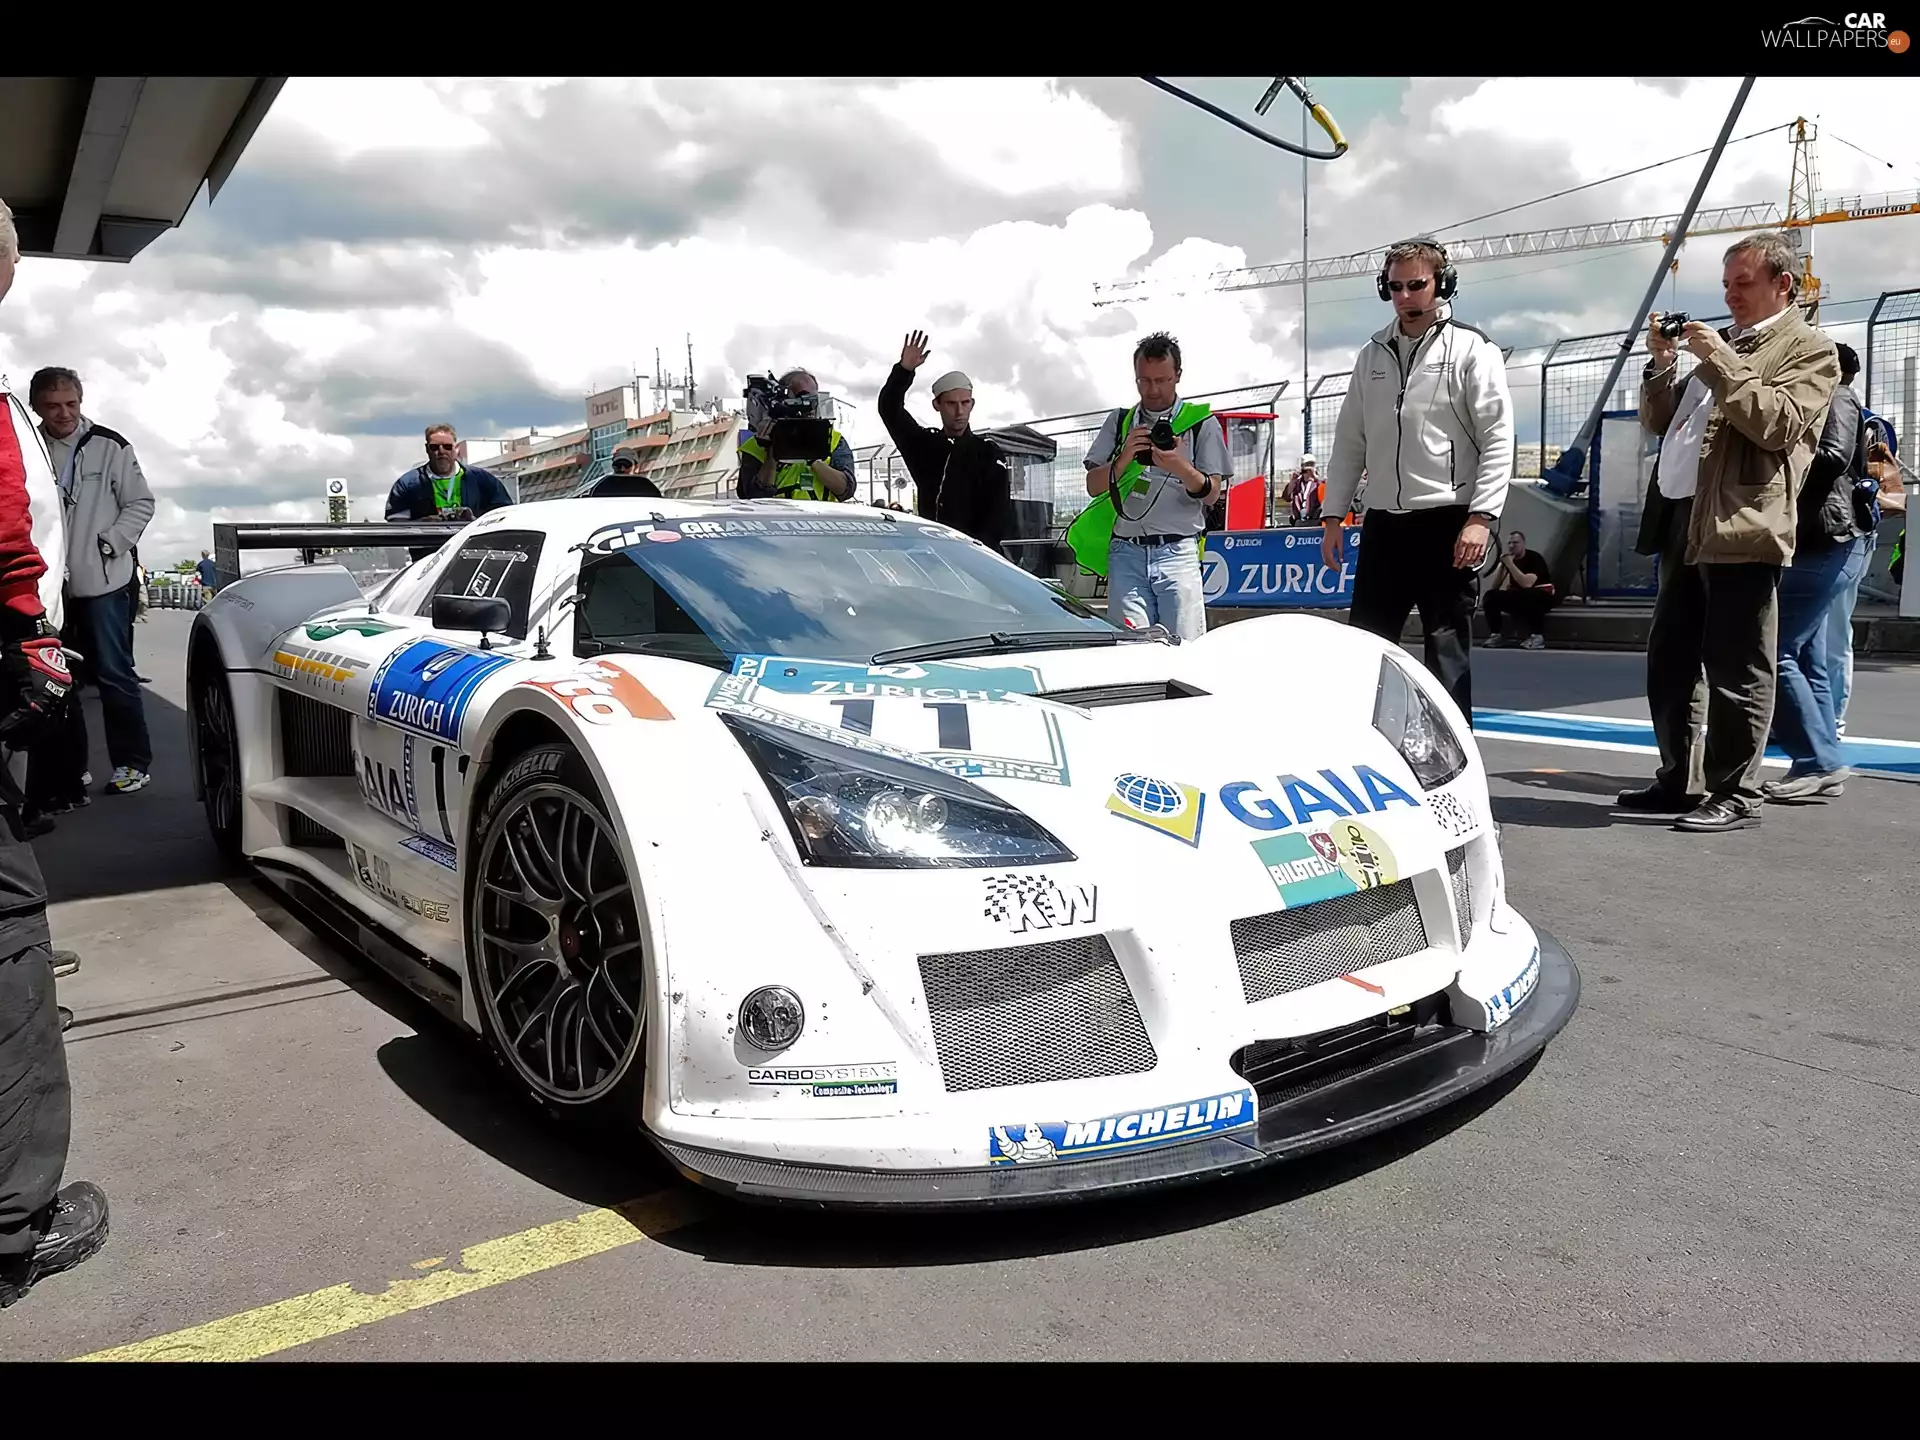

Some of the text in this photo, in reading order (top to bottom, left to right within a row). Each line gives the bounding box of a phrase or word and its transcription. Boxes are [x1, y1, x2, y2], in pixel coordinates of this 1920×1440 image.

[679, 521, 767, 534] GRAN
[771, 520, 898, 532] TURISMO
[1236, 538, 1262, 547] ZURICH
[1297, 537, 1325, 545] ZURIC
[389, 690, 445, 733] ZURICH
[811, 680, 988, 701] ZURICH
[830, 699, 972, 751] 11
[1219, 765, 1421, 831] GAIA
[1006, 882, 1097, 934] KW
[1062, 1094, 1243, 1147] MICHELIN
